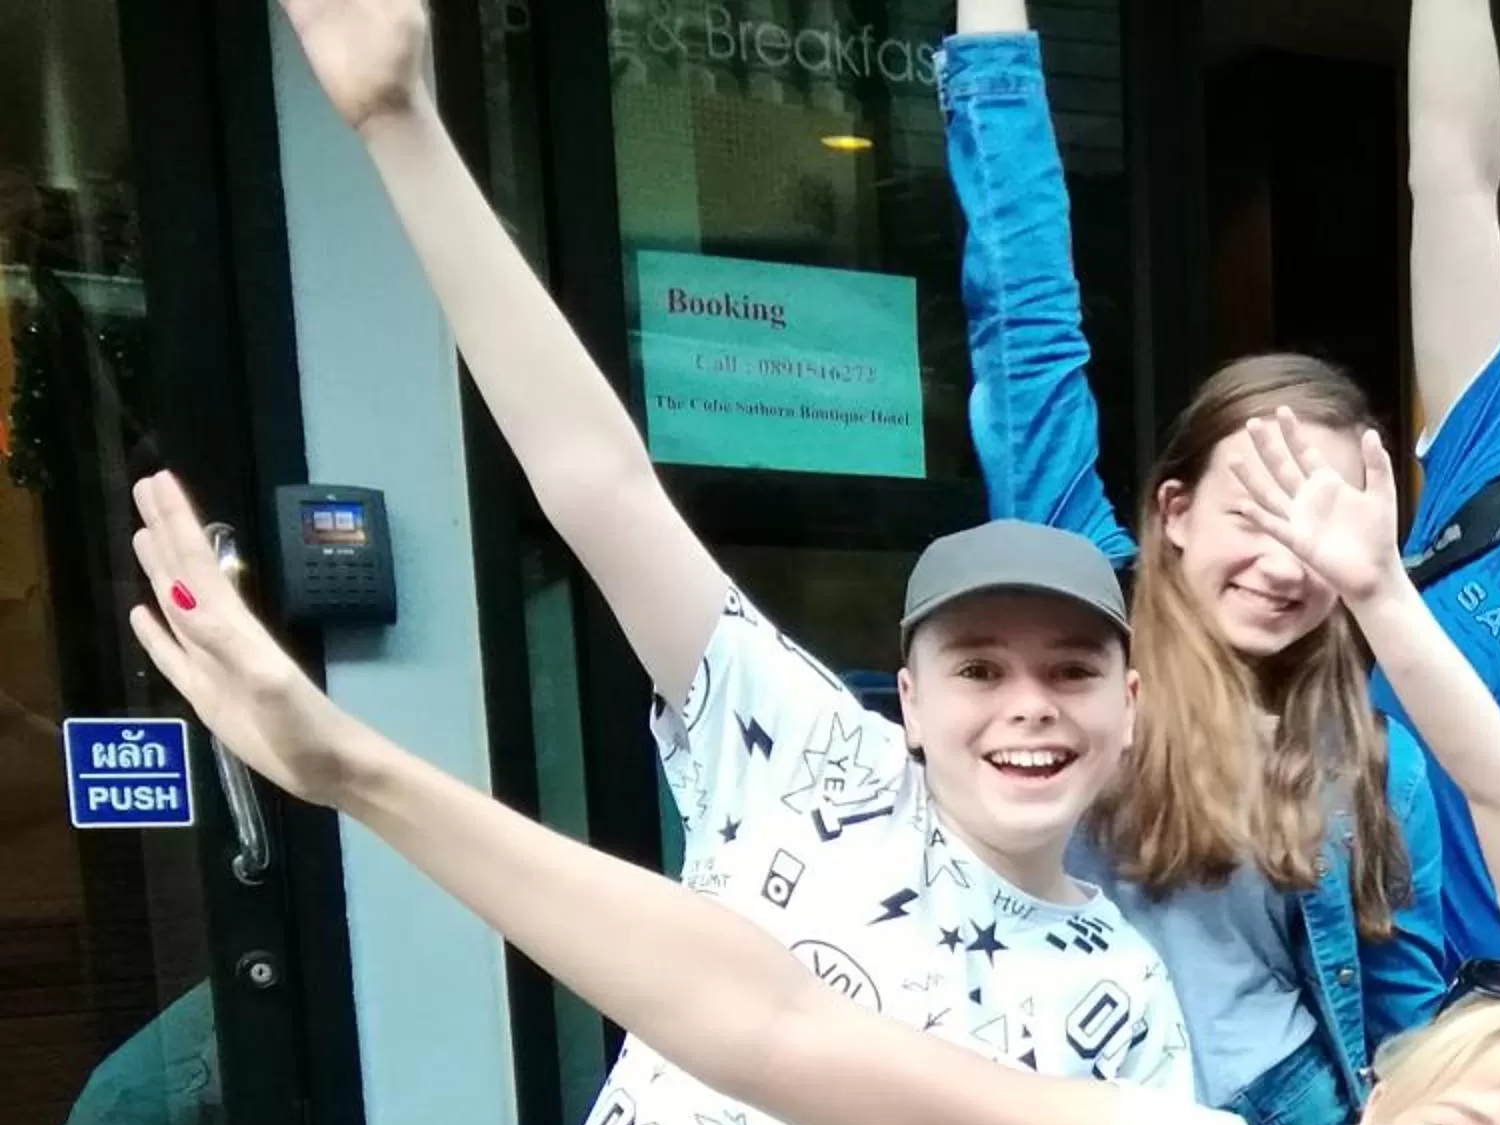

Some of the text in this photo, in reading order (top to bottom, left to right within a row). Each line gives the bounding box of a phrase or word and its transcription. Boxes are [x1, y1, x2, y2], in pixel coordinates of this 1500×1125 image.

[704, 3, 938, 86] Breakfas
[667, 287, 787, 330] Booking
[656, 394, 685, 411] The
[800, 404, 865, 428] Boutique
[871, 409, 910, 427] Hotel
[91, 729, 165, 769] ผลัก
[88, 785, 179, 811] PUSH
